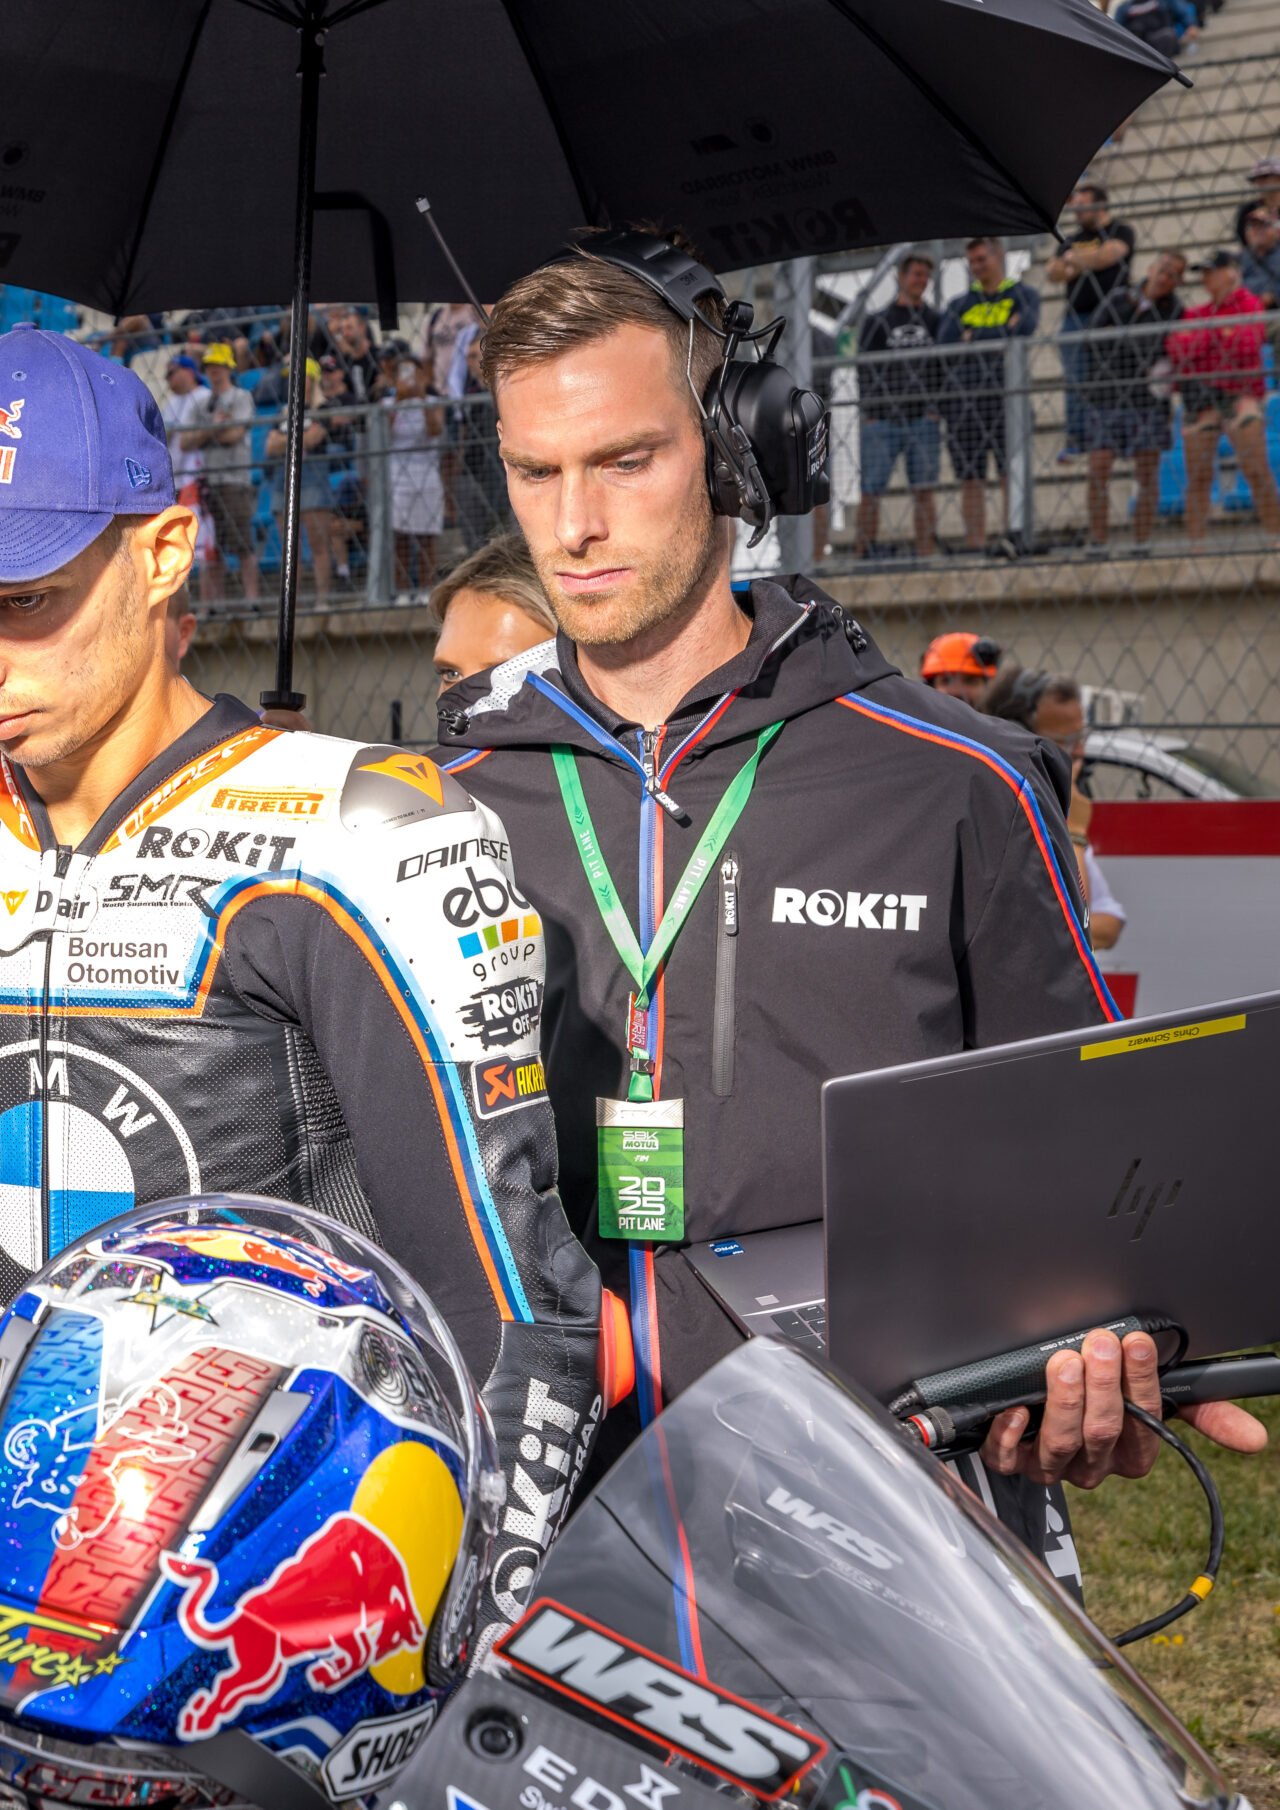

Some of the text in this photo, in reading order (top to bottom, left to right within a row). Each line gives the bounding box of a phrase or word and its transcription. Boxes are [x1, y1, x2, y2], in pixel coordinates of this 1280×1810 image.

[680, 272, 698, 286] 3M
[211, 788, 324, 815] PIRELLI
[396, 838, 509, 882] DAINESE
[580, 829, 603, 879] PIT LANE
[673, 857, 707, 911] PIT LANE
[104, 873, 224, 920] SMR
[69, 937, 168, 959] Borusan
[67, 961, 180, 986] Otomotiv
[473, 943, 536, 982] group
[512, 1013, 530, 1035] OFF
[1128, 1026, 1200, 1048] Chris Schwarz
[622, 1131, 658, 1140] SBK
[625, 1140, 657, 1149] MOTUL
[618, 1176, 665, 1196] 20
[618, 1196, 666, 1216] 25
[618, 1217, 666, 1231] PIT LANE
[549, 1394, 603, 1550] TORRAD
